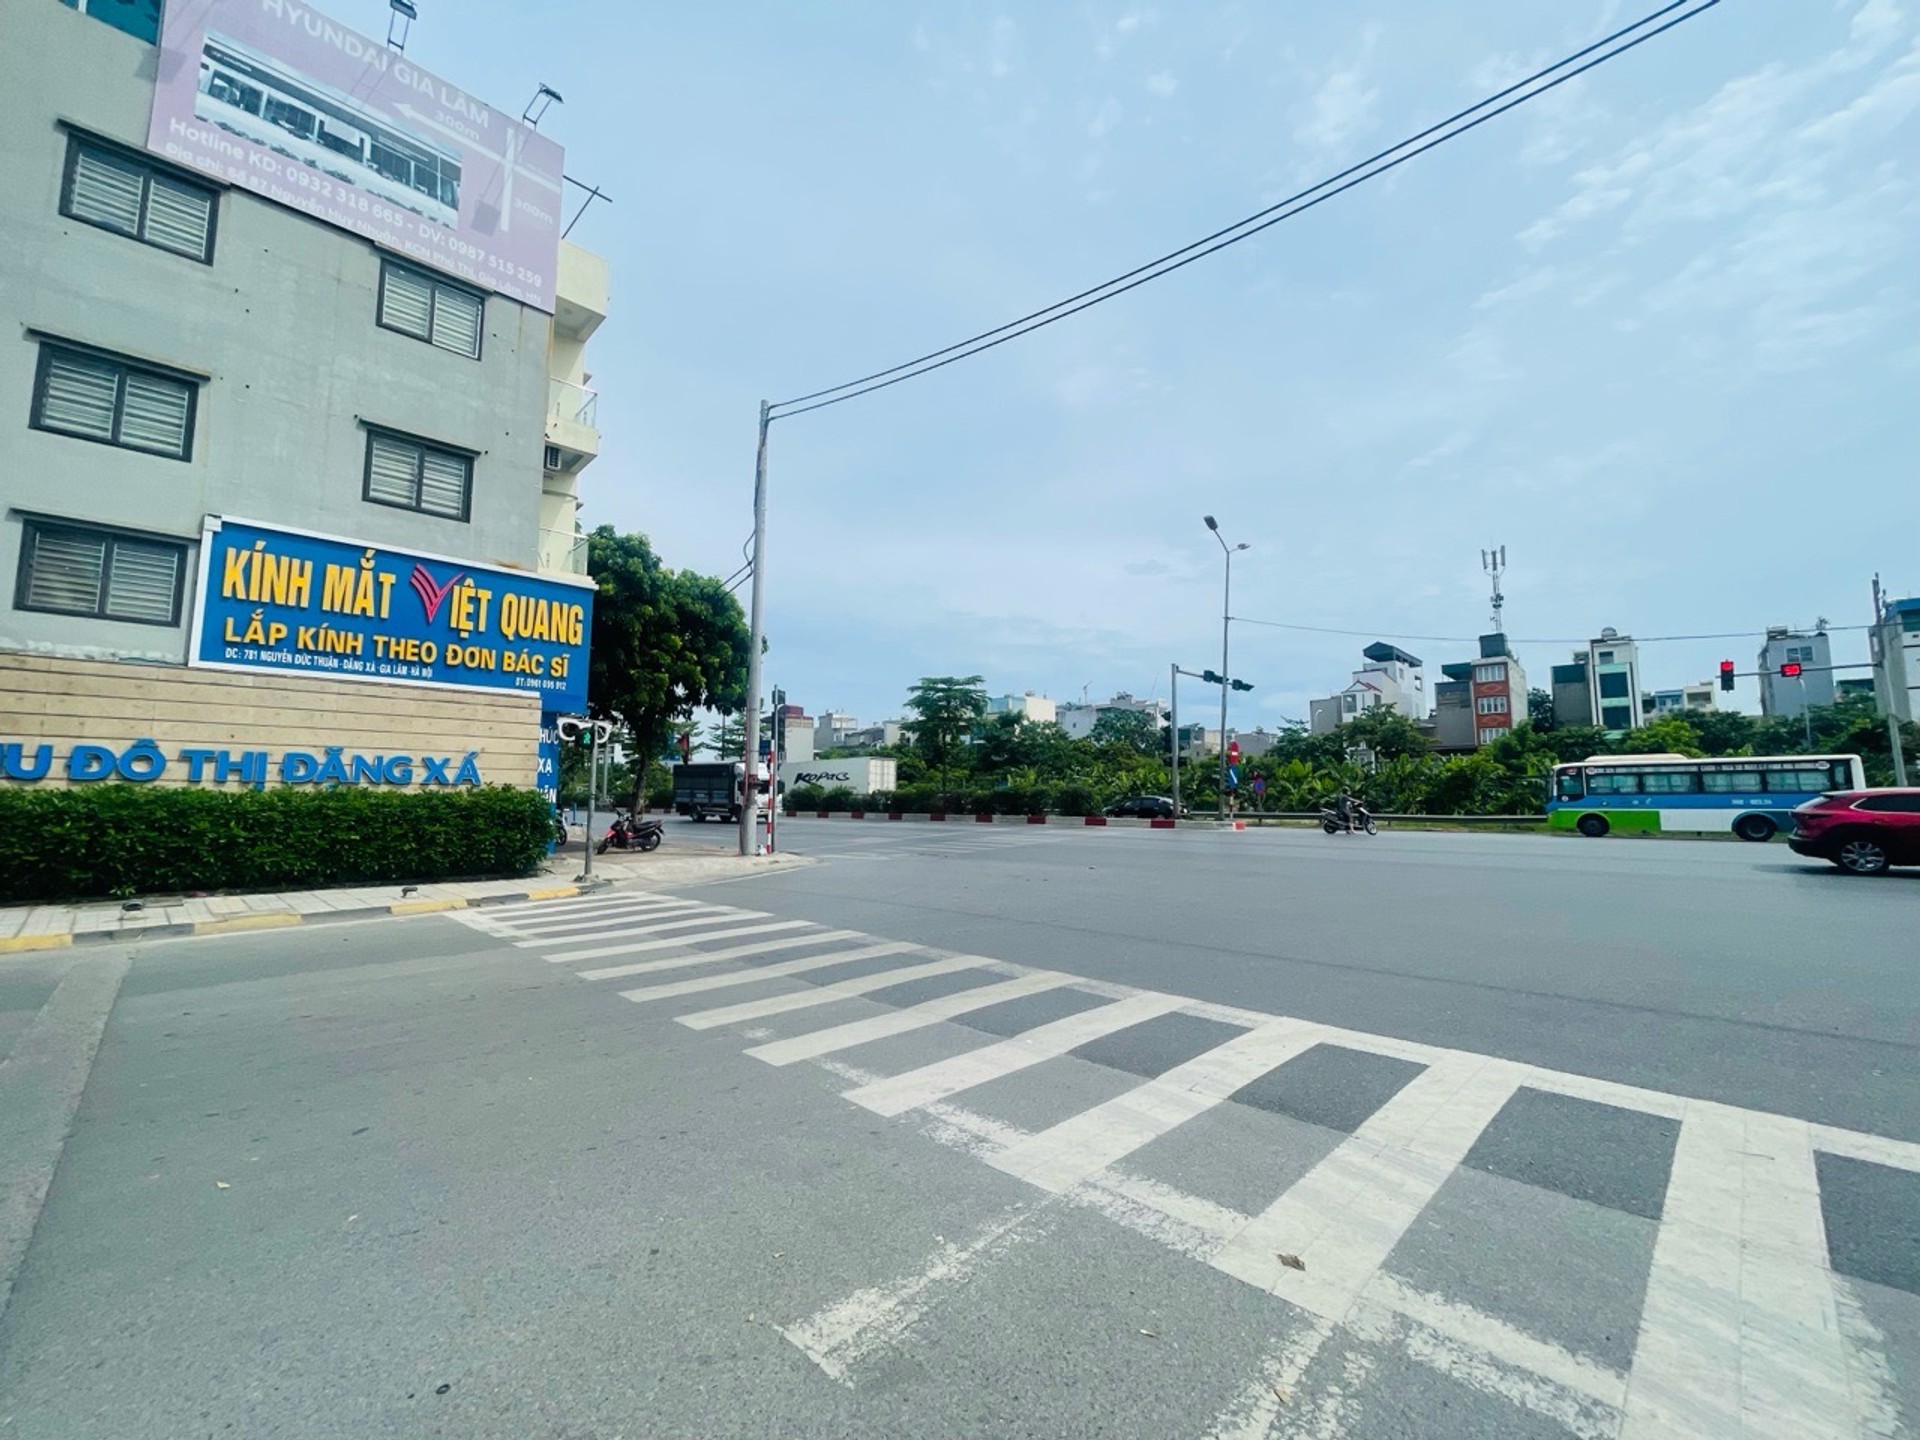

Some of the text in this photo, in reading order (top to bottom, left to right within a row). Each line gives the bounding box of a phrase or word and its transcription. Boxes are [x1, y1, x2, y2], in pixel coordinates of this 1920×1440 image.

[261, 0, 388, 71] HYUNDAI
[393, 62, 434, 99] GIA
[440, 86, 490, 128] LÂM
[169, 117, 245, 160] Hotline
[248, 150, 283, 176] KD:
[286, 167, 333, 197] 0932
[336, 188, 369, 211] 318
[372, 205, 404, 227] 665
[418, 223, 446, 246] DV:
[448, 237, 486, 261] 0987
[489, 255, 515, 275] 515
[517, 267, 543, 287] 259
[222, 540, 584, 646] KÍNH MẮT VIỆT QUANG
[225, 608, 571, 678] LẮP KÍNH THEO ĐƠN BÁC SĨ
[0, 737, 482, 792] U ĐÔ THỊ ĐẶNG XÁ
